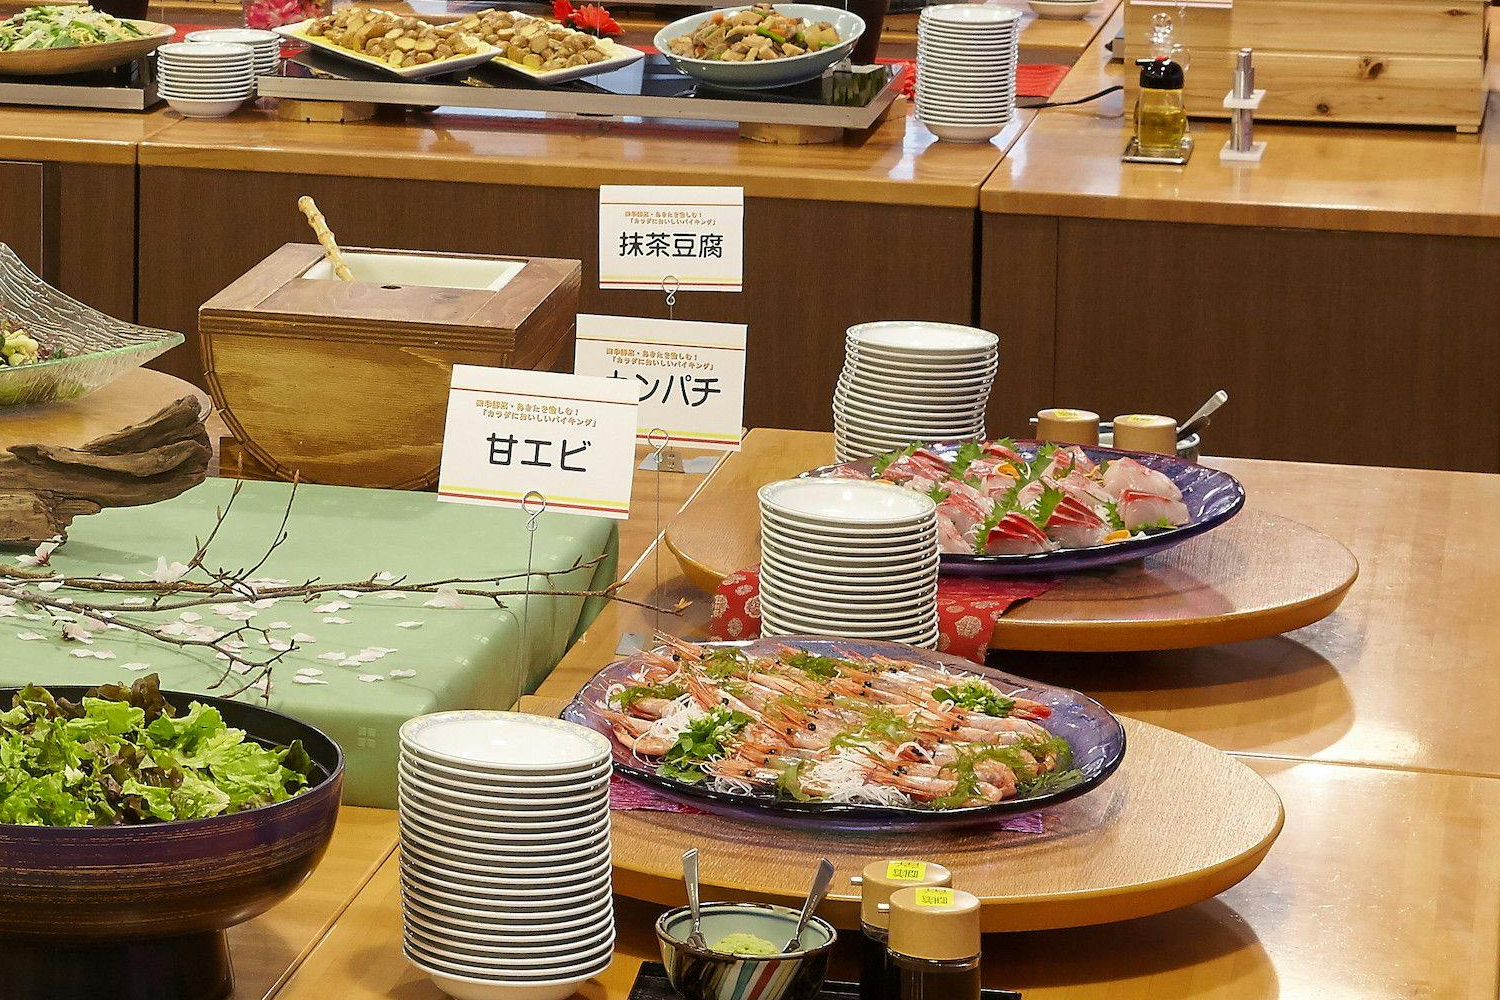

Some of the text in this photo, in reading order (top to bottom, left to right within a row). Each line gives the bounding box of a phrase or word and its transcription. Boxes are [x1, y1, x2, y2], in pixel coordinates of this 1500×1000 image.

[618, 231, 724, 259] 抹茶豆腐
[486, 432, 592, 473] 甘エビ
